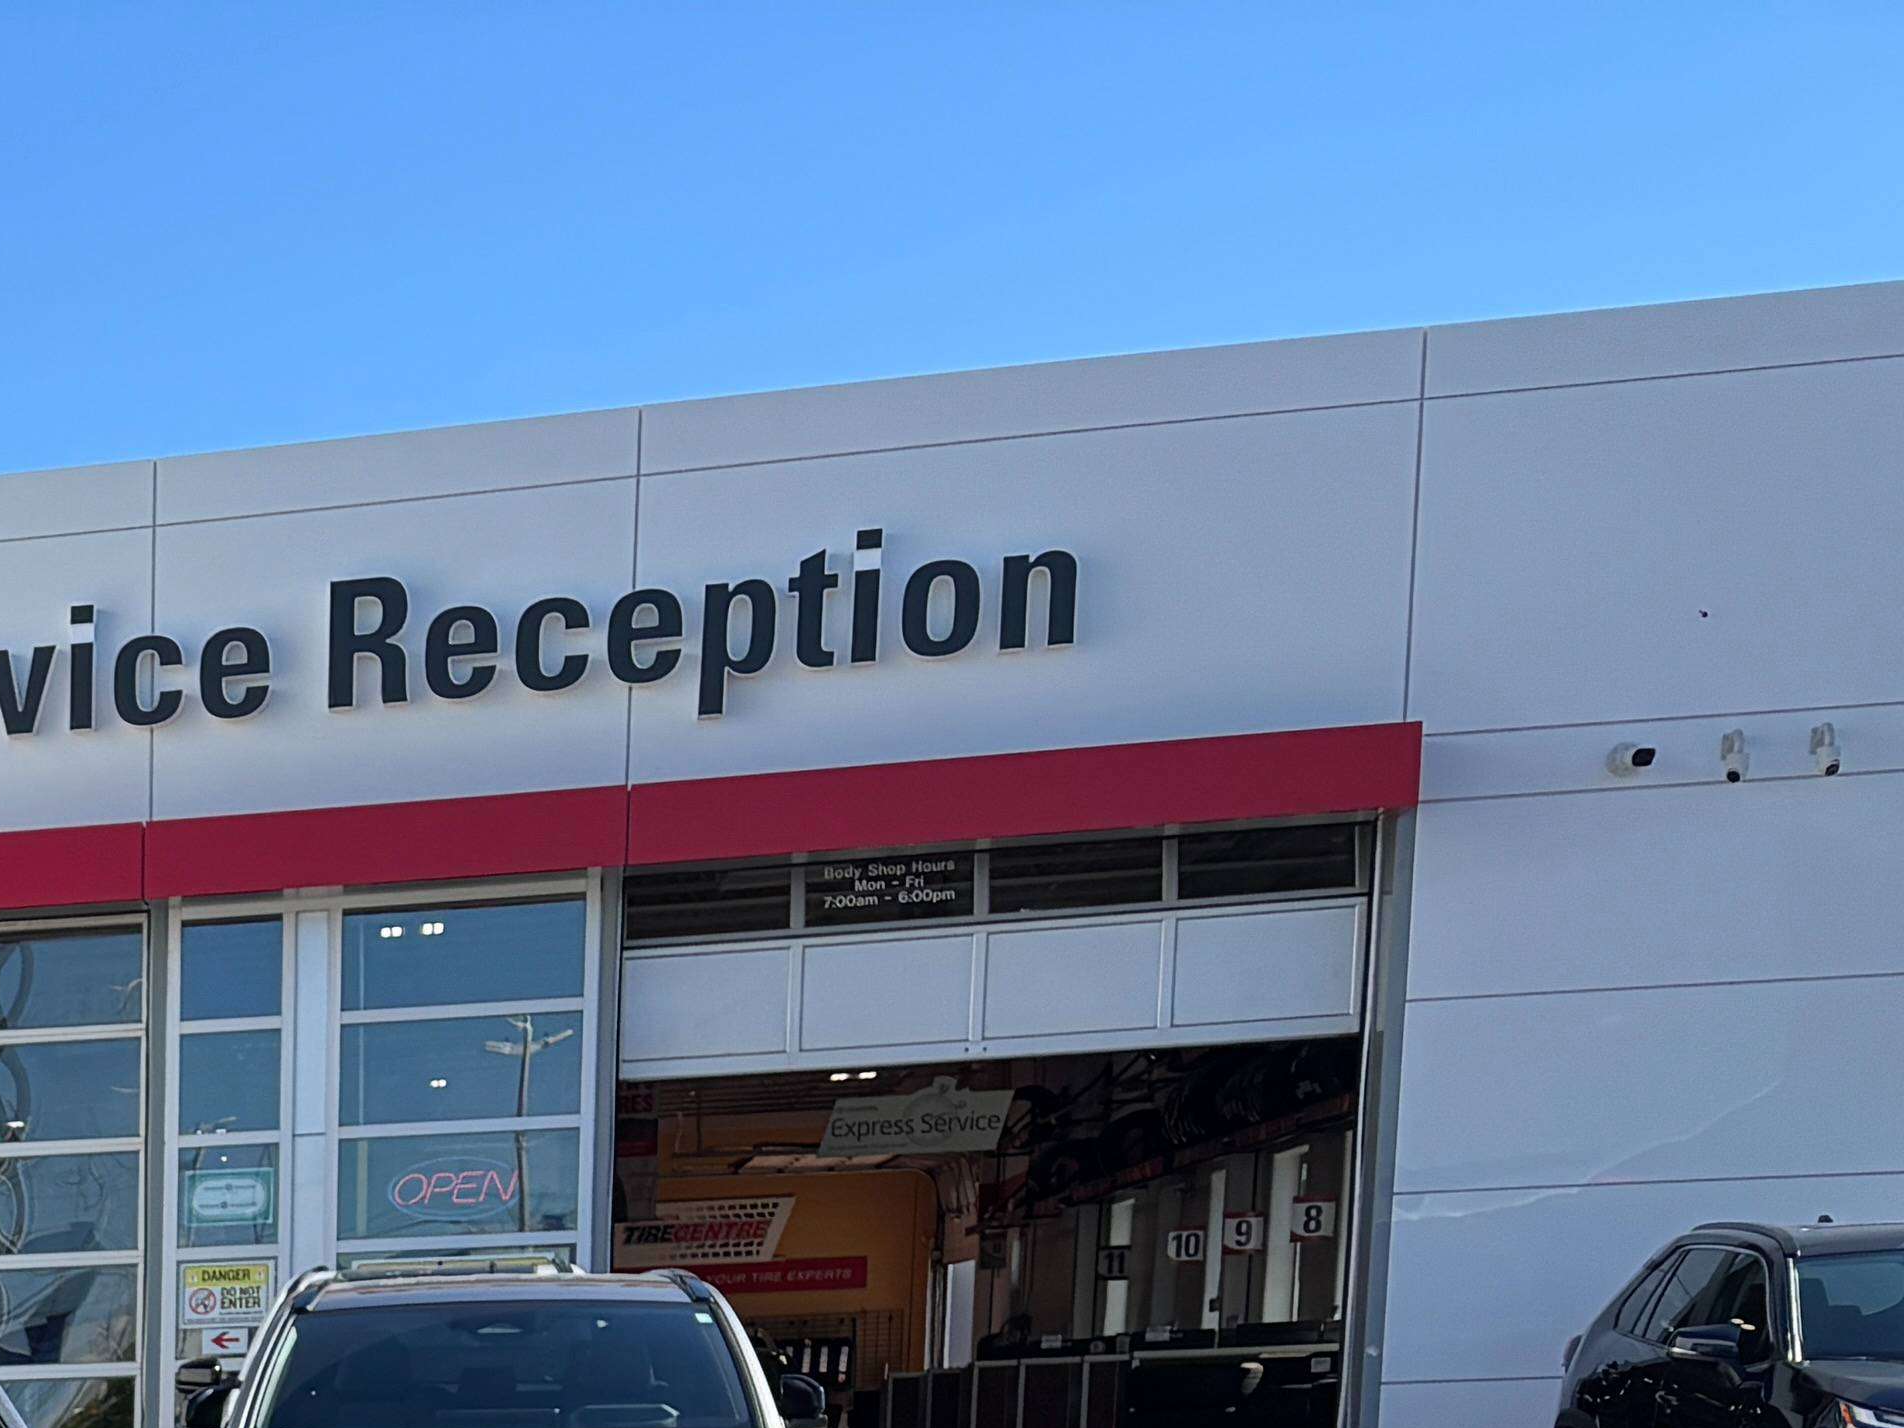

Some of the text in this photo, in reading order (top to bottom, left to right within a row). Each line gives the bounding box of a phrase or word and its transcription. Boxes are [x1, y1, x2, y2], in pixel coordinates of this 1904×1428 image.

[327, 528, 1078, 720] Reception
[823, 860, 956, 880] Body Shop Hours
[854, 879, 886, 892] Mon
[905, 876, 924, 888] Fri
[823, 894, 879, 909] 7:00am
[898, 889, 956, 904] 6:00pm
[830, 1110, 1001, 1142] Express Service
[394, 1169, 519, 1206] OPEN
[1302, 1204, 1323, 1235] 8
[1234, 1219, 1253, 1247] 9
[1171, 1232, 1200, 1258] 10
[1104, 1251, 1126, 1274] 11
[201, 1268, 251, 1282] DANGER
[706, 1268, 853, 1285] YOUR TIRE EXPERTS
[220, 1286, 262, 1297] DO NOT
[220, 1297, 262, 1310] ENTER
